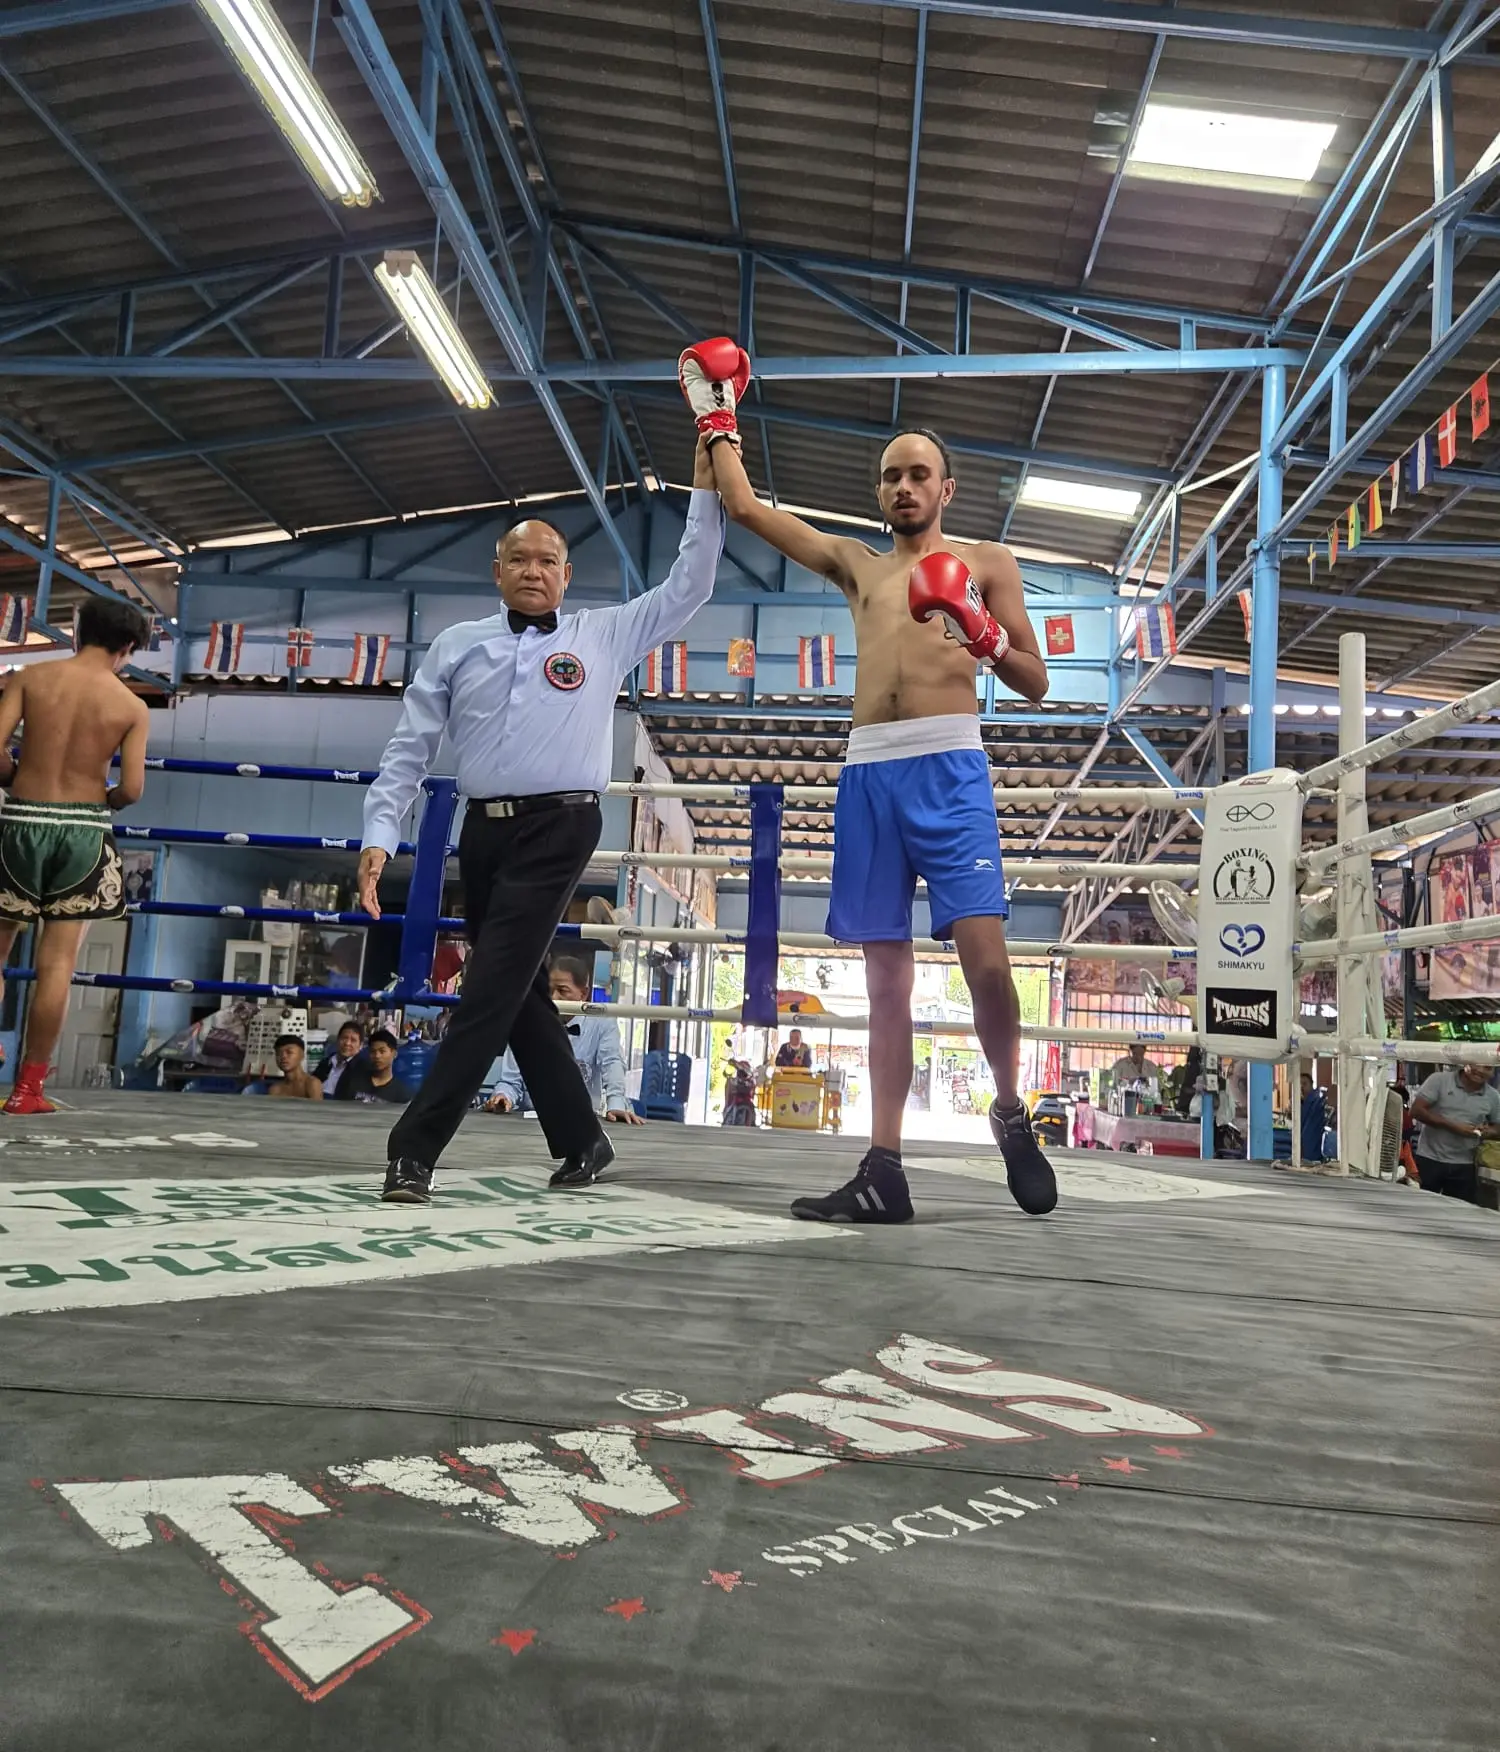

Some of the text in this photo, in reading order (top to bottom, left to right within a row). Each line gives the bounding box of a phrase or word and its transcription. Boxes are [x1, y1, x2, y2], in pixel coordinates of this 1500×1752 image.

[1223, 847, 1268, 865] BOXING
[1217, 960, 1265, 971] SHIMAKYU
[1212, 996, 1270, 1027] TWINS
[48, 1332, 1208, 1690] TWINS
[761, 1484, 1060, 1578] SPECIAL
